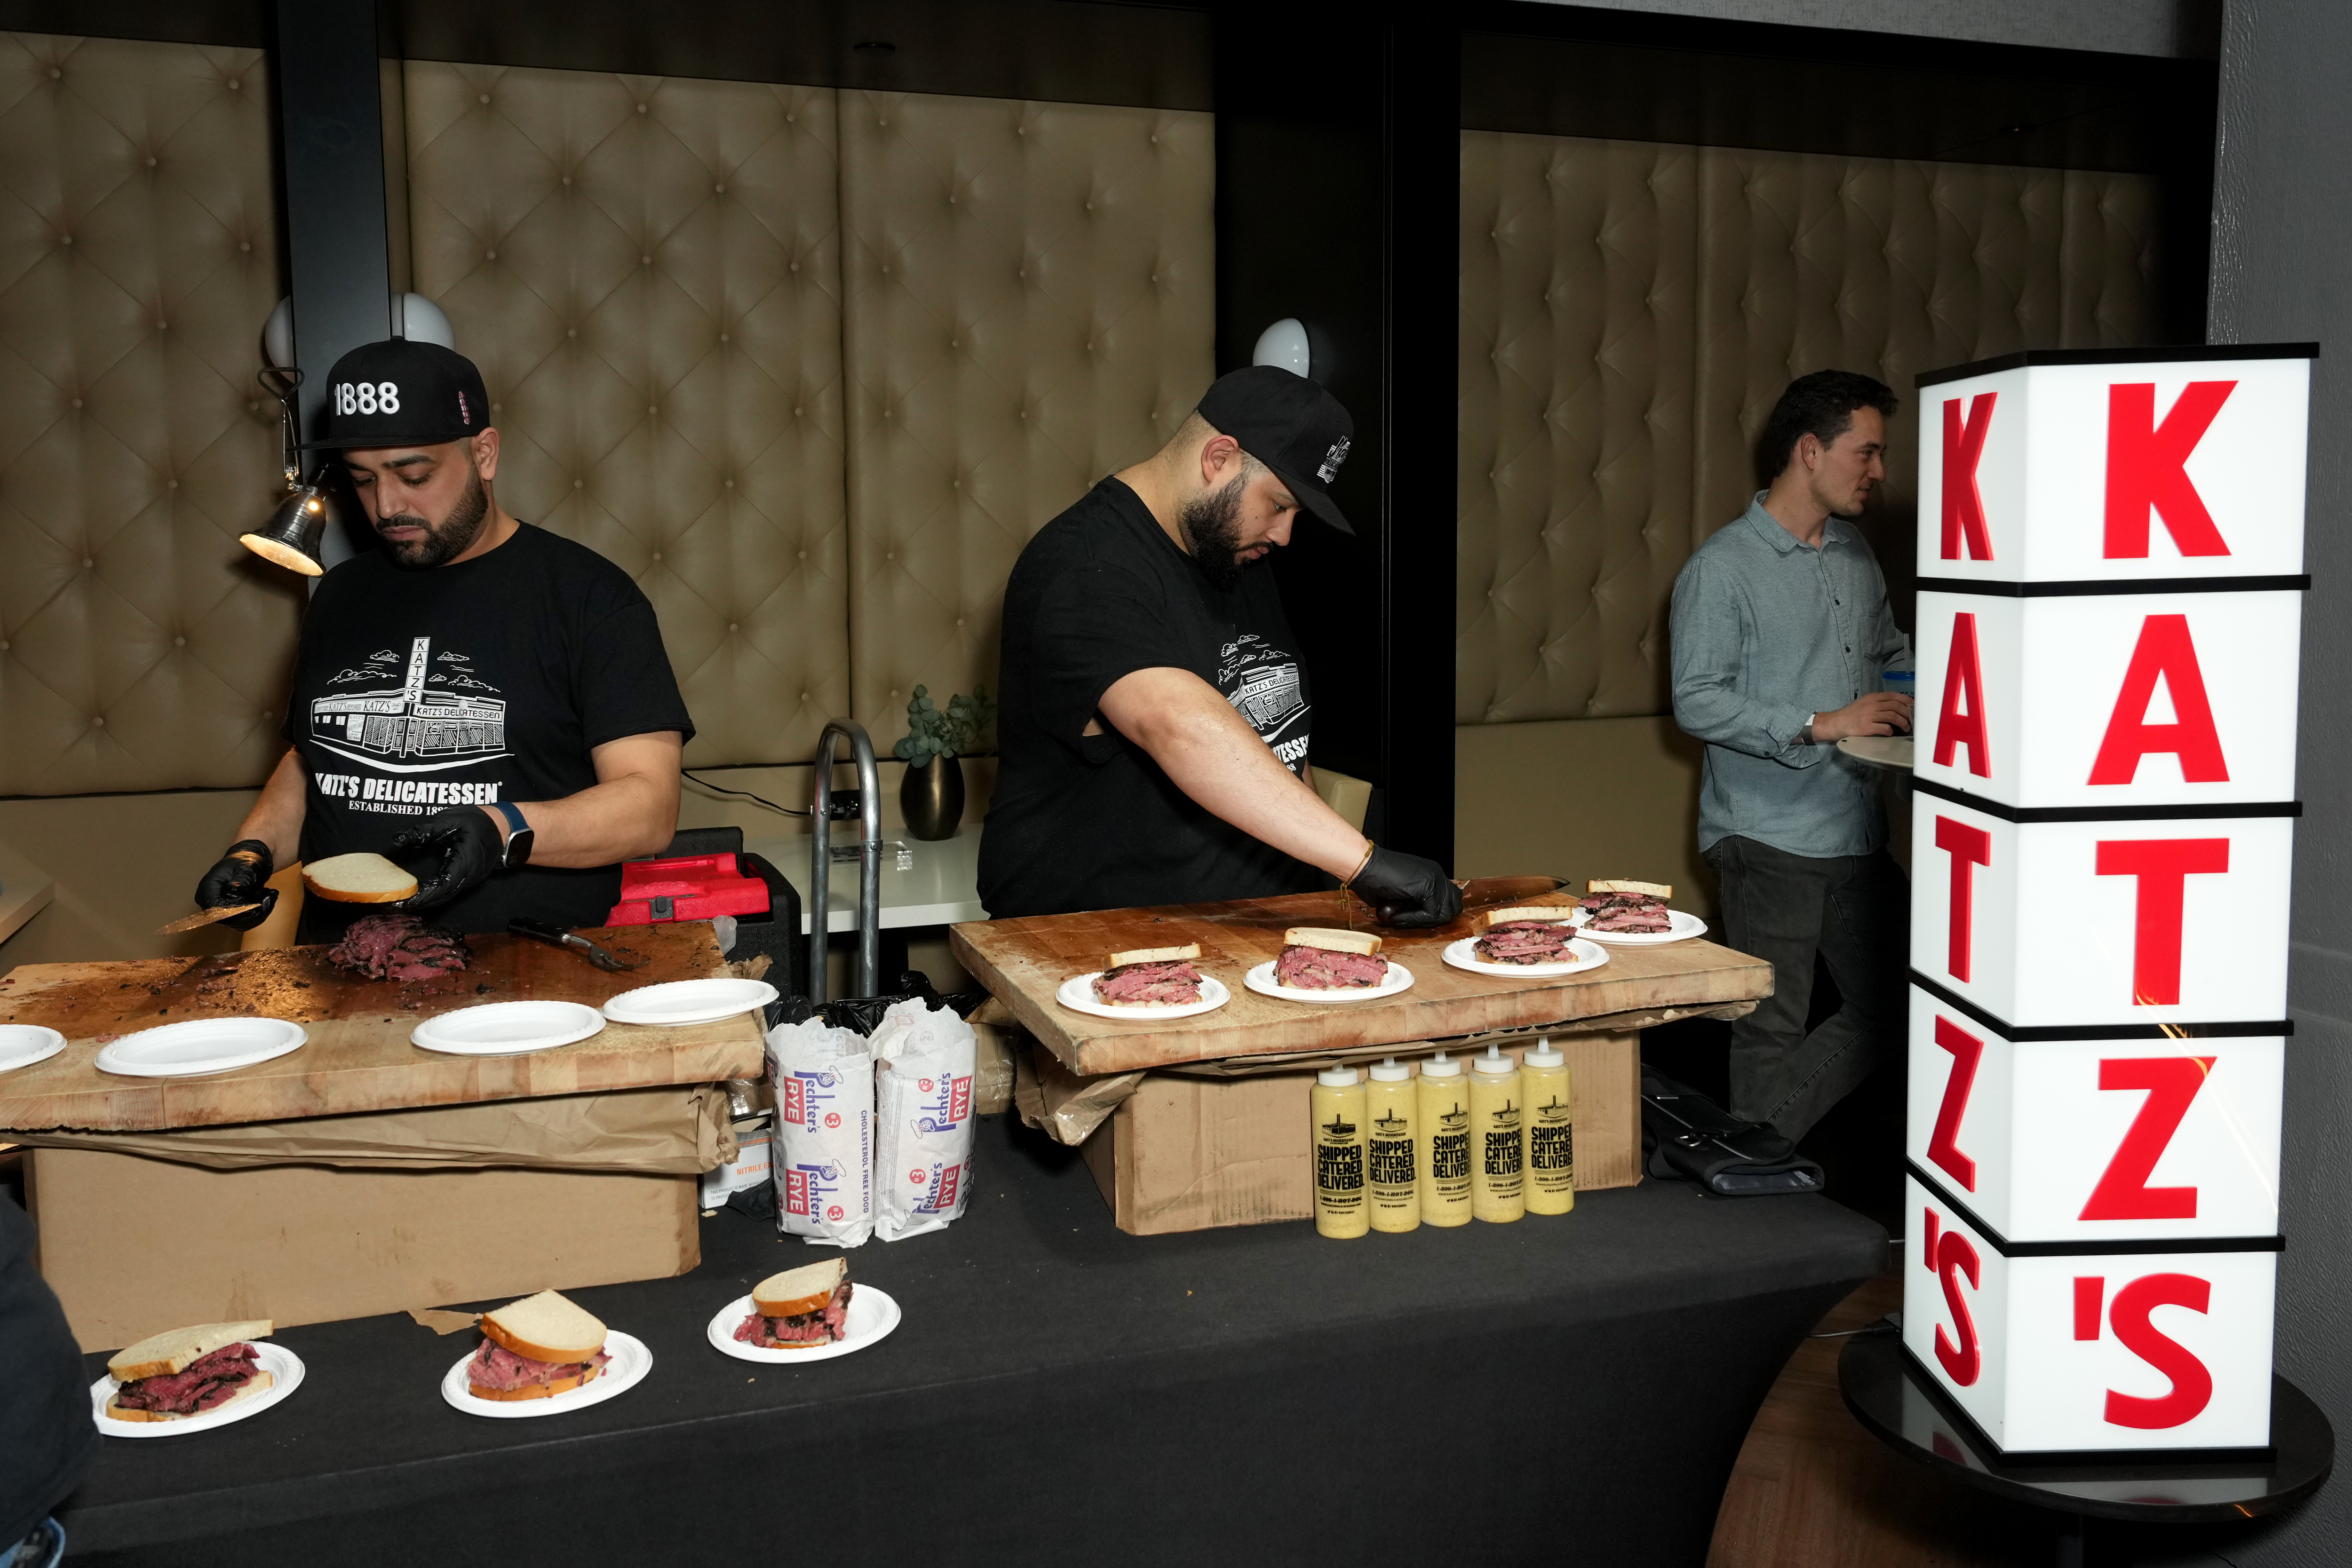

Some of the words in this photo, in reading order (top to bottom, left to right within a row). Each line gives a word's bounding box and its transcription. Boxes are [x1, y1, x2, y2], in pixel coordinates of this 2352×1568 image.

[334, 381, 400, 416] 1888
[407, 640, 425, 701] KATZ'S
[1244, 682, 1268, 695] KATZ'S
[1269, 674, 1298, 686] DELICATESSEN
[329, 702, 347, 711] KATZ'S
[363, 701, 391, 712] KATZ'S
[417, 707, 442, 716] KATZ'S
[445, 708, 500, 719] DELICATESSEN
[1287, 763, 1296, 772] 88
[315, 773, 360, 798] KATZ'S
[363, 778, 498, 805] DELICATESSEN
[349, 800, 423, 816] ESTABLISHED
[426, 806, 448, 816] 18
[1924, 392, 1998, 1386] KATZ'S
[2073, 380, 2239, 1430] KATZ'S
[921, 1080, 933, 1091] #3
[787, 1081, 800, 1120] RYE
[954, 1080, 969, 1118] RYE
[826, 1114, 839, 1126] #3
[1433, 1130, 1470, 1150] SHIPPE
[1486, 1127, 1522, 1146] SHIPPE
[1531, 1123, 1572, 1140] SHIPPED
[1318, 1144, 1362, 1161] SHIPPED
[1369, 1139, 1413, 1155] SHIPPED
[1433, 1146, 1470, 1164] CATERE
[1486, 1142, 1523, 1160] CATERE
[737, 1163, 762, 1175] NITRILE
[1318, 1158, 1363, 1175] CATERED
[1369, 1153, 1414, 1169] CATERED
[1433, 1160, 1471, 1178] DELIVERE
[1485, 1157, 1523, 1174] DELIVERE
[912, 1171, 925, 1182] #3
[1318, 1172, 1365, 1190] DELIVERED.
[1370, 1167, 1416, 1184] DELIVERED.
[789, 1173, 804, 1212] RYE
[939, 1169, 957, 1205] RYE
[829, 1207, 842, 1219] #3
